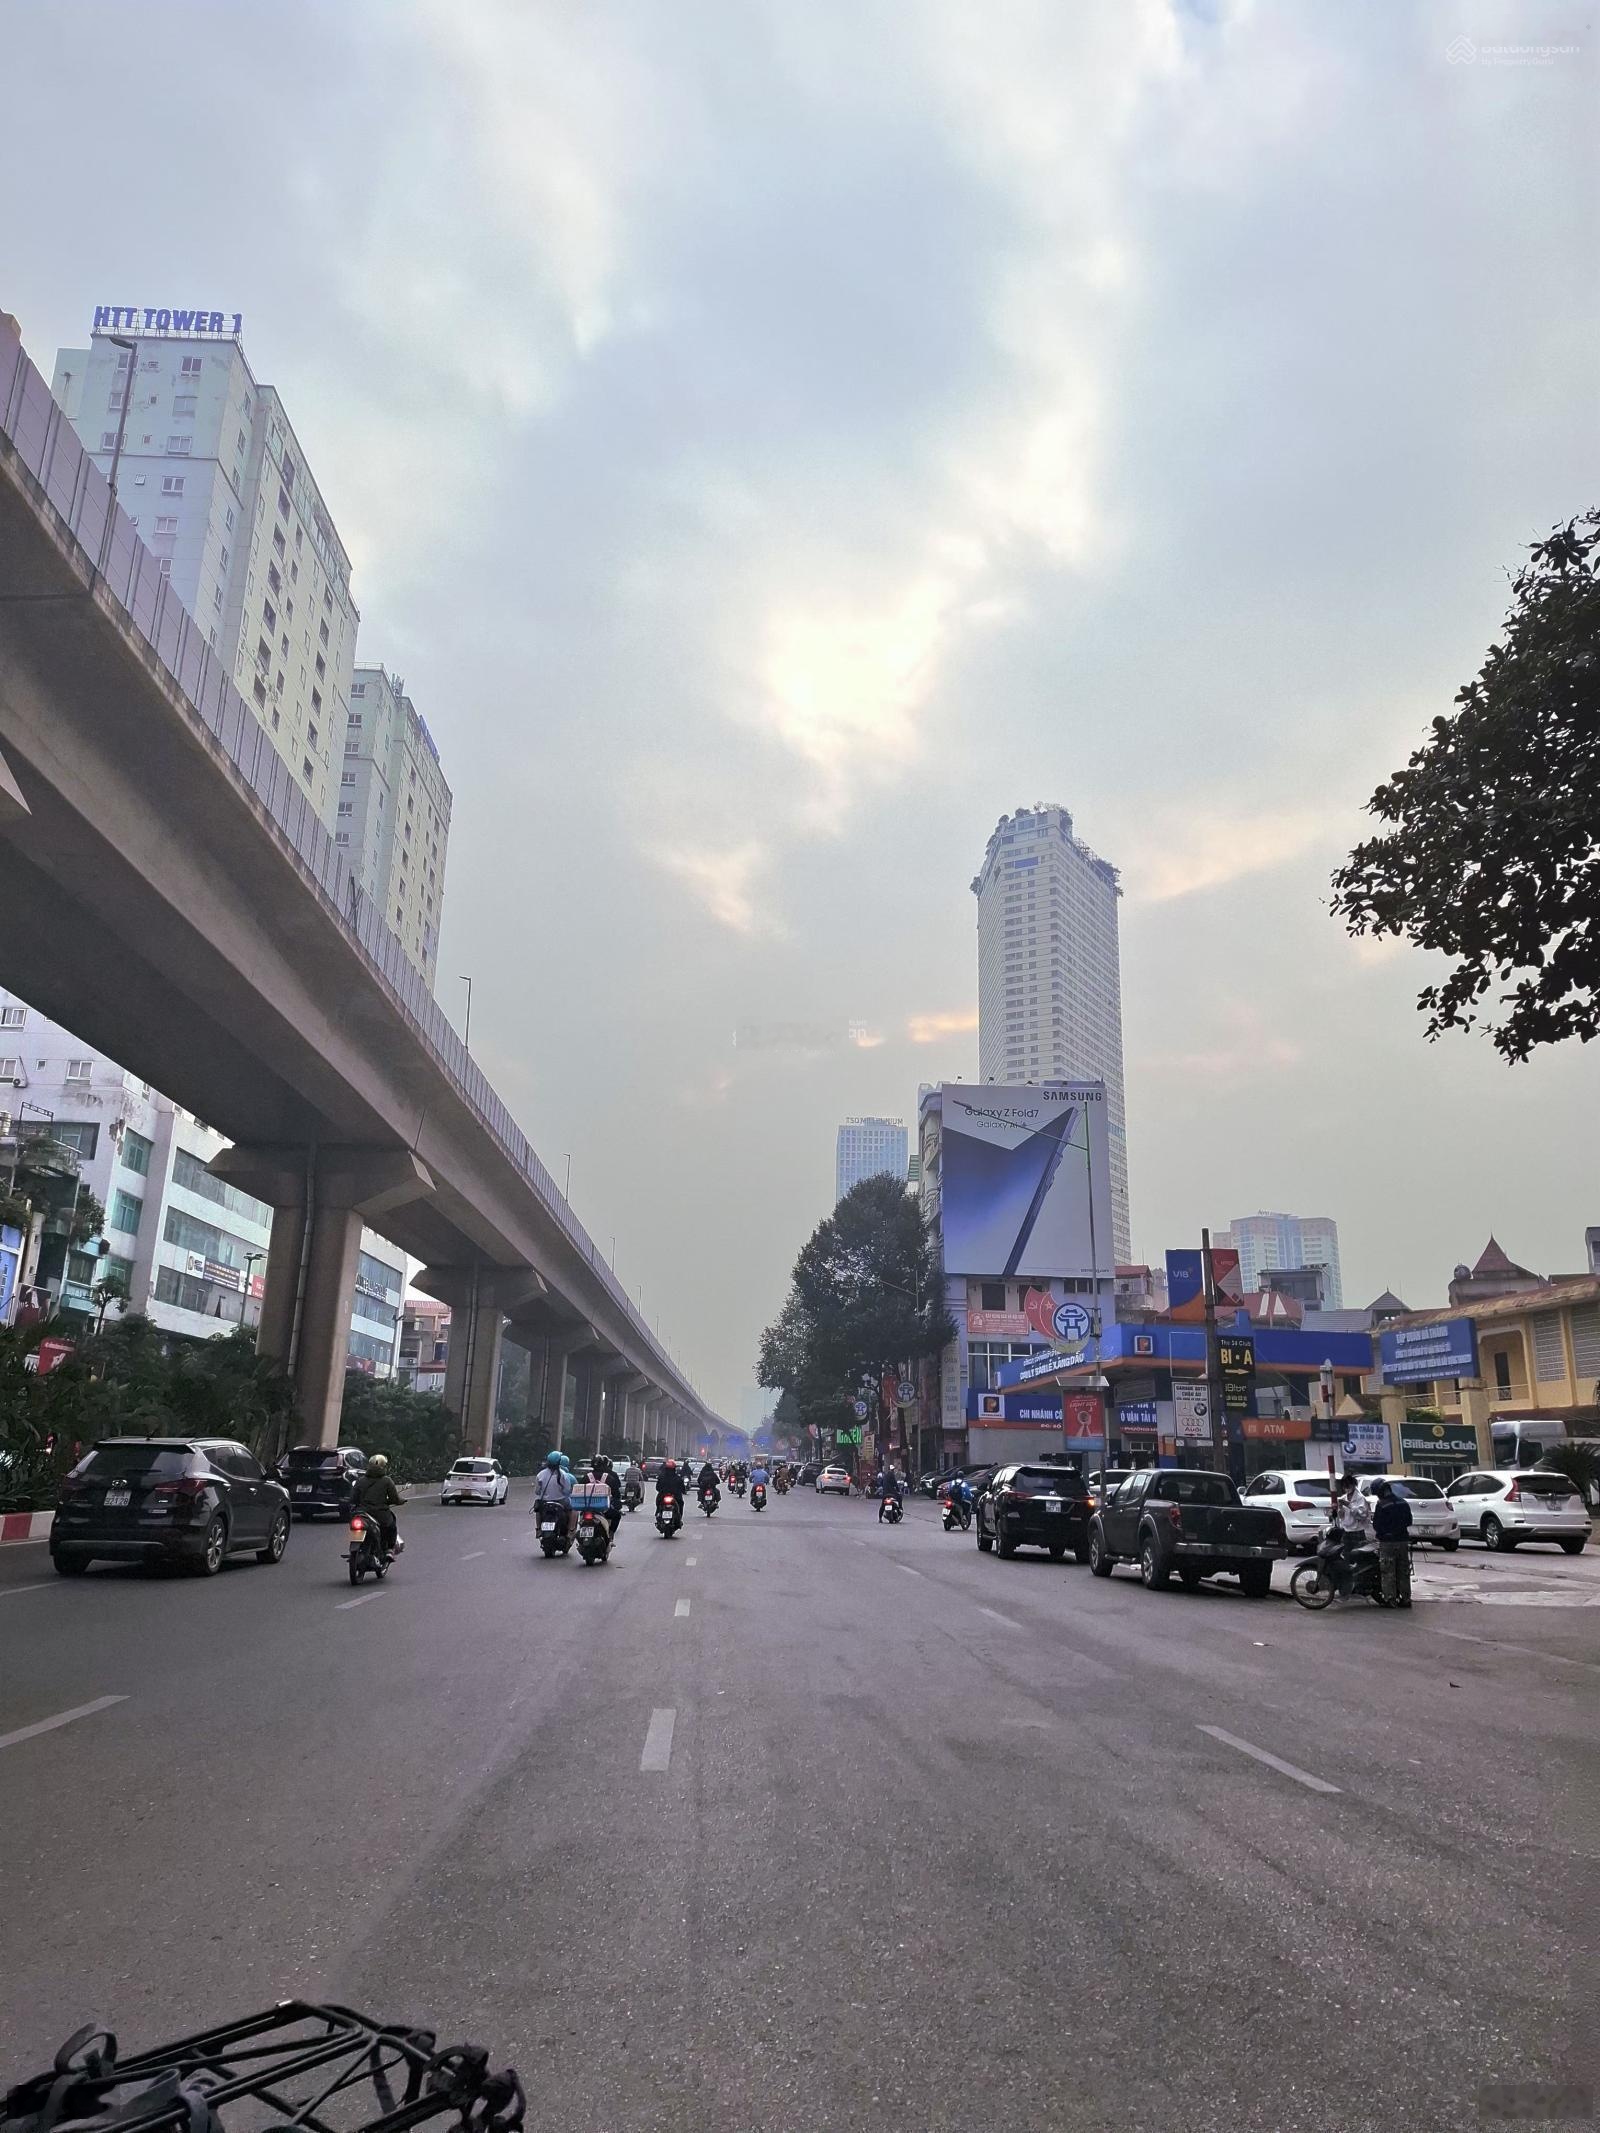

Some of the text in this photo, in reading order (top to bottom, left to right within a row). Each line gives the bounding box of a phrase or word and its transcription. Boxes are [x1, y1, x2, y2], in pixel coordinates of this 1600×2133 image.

[94, 306, 242, 333] HTT TOWER 1
[1043, 1091, 1102, 1101] SAMSUNG
[965, 1108, 1003, 1118] Galaxy
[1012, 1109, 1040, 1118] Fold7
[976, 1121, 1008, 1131] Galaxy
[1020, 1409, 1030, 1419] CHI
[1031, 1409, 1053, 1420] NHÁNH
[1152, 1414, 1157, 1423] H
[1263, 1424, 1285, 1434] ATM
[1403, 1438, 1477, 1451] Billiards Club
